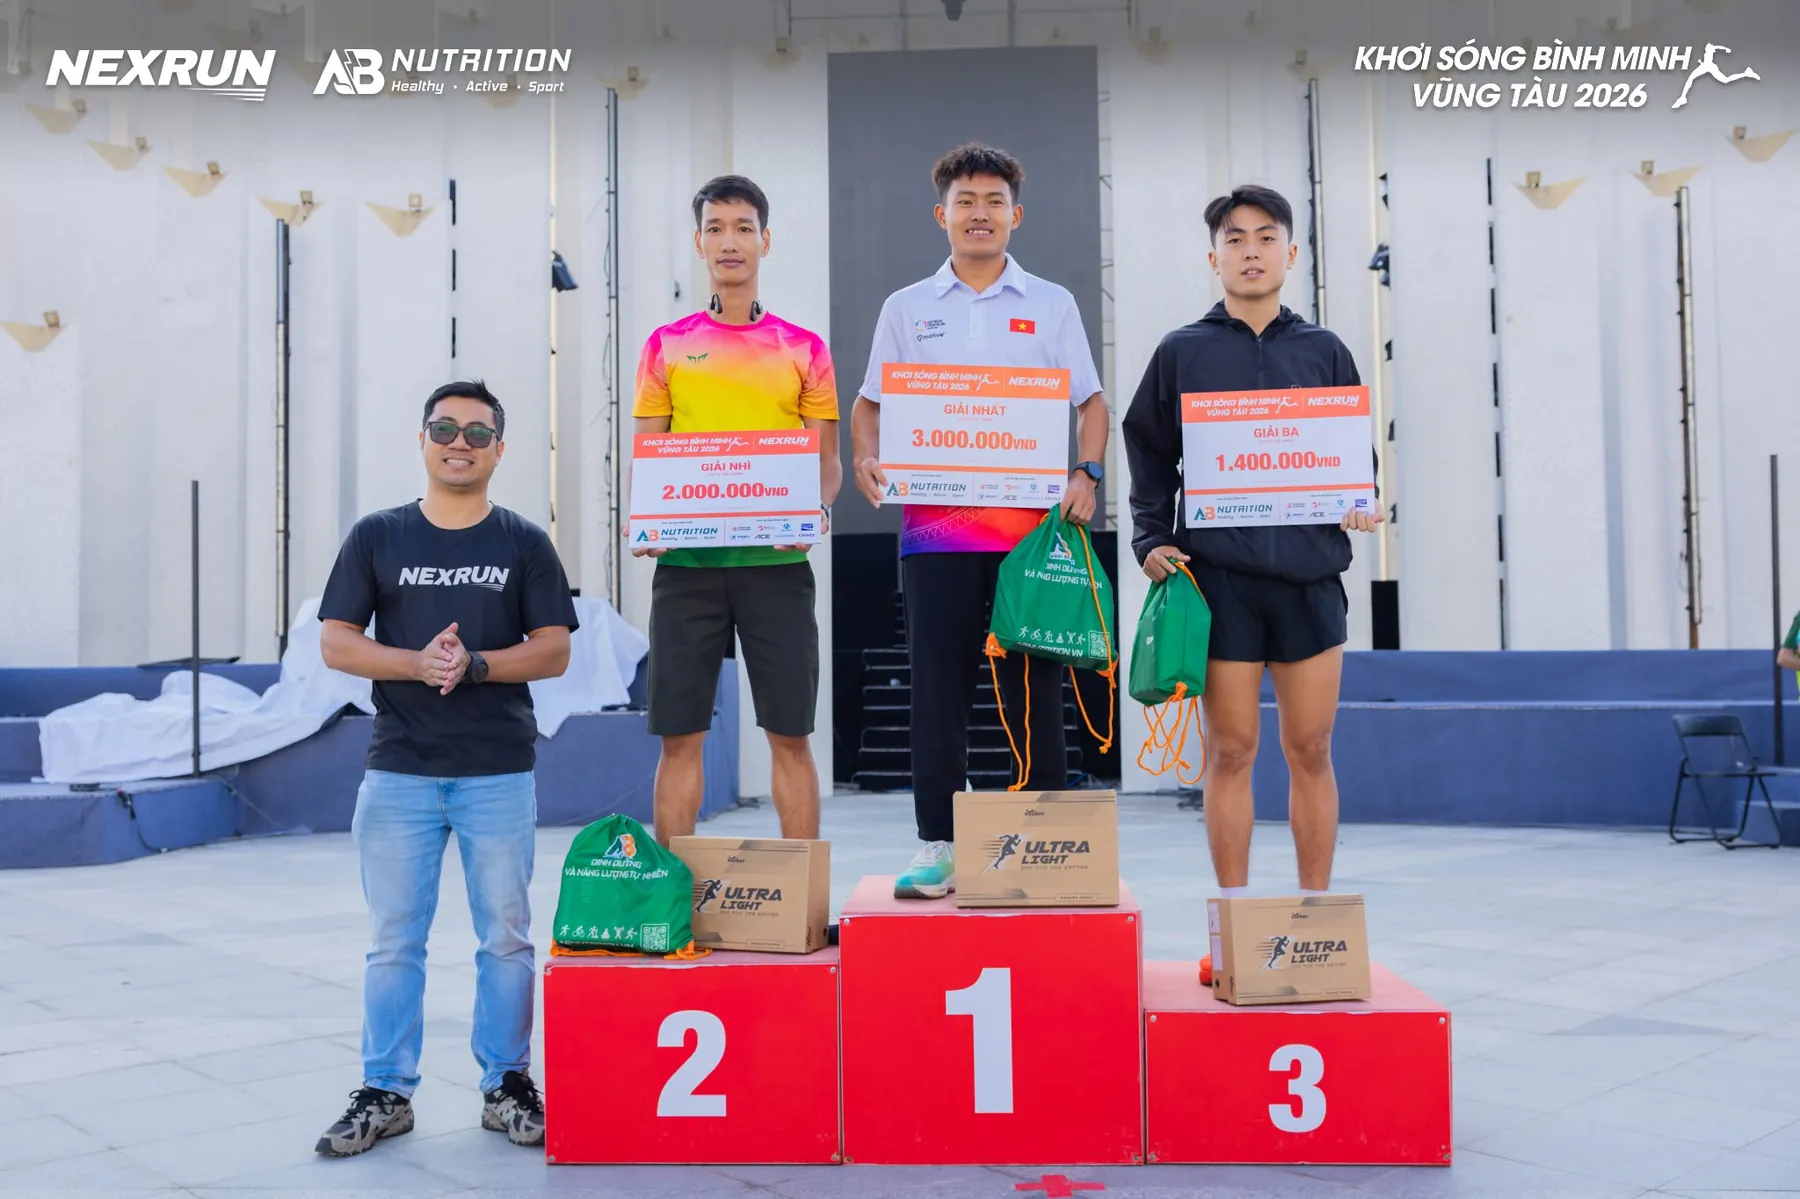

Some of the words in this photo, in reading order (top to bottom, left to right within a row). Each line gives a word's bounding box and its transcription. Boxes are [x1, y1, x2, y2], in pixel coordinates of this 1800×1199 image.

[1008, 376, 1061, 390] NEXRUN
[1307, 395, 1360, 407] NEXRUN
[1282, 426, 1300, 438] BA
[758, 436, 809, 446] NEXRUN
[910, 482, 967, 492] NUTRITION
[1216, 504, 1273, 514] NUTRITION
[661, 527, 718, 536] NUTRITION
[398, 565, 510, 587] NEXRUN
[1025, 840, 1090, 854] ULTRA
[1021, 855, 1069, 865] LIGHT
[565, 866, 576, 876] VÀ
[724, 886, 782, 902] ULTRA
[720, 900, 762, 911] LIGHT
[1293, 940, 1348, 954] ULTRA
[1291, 953, 1330, 964] LIGHT
[946, 968, 1013, 1114] 1
[657, 1010, 727, 1117] 2
[1268, 1044, 1327, 1133] 3
